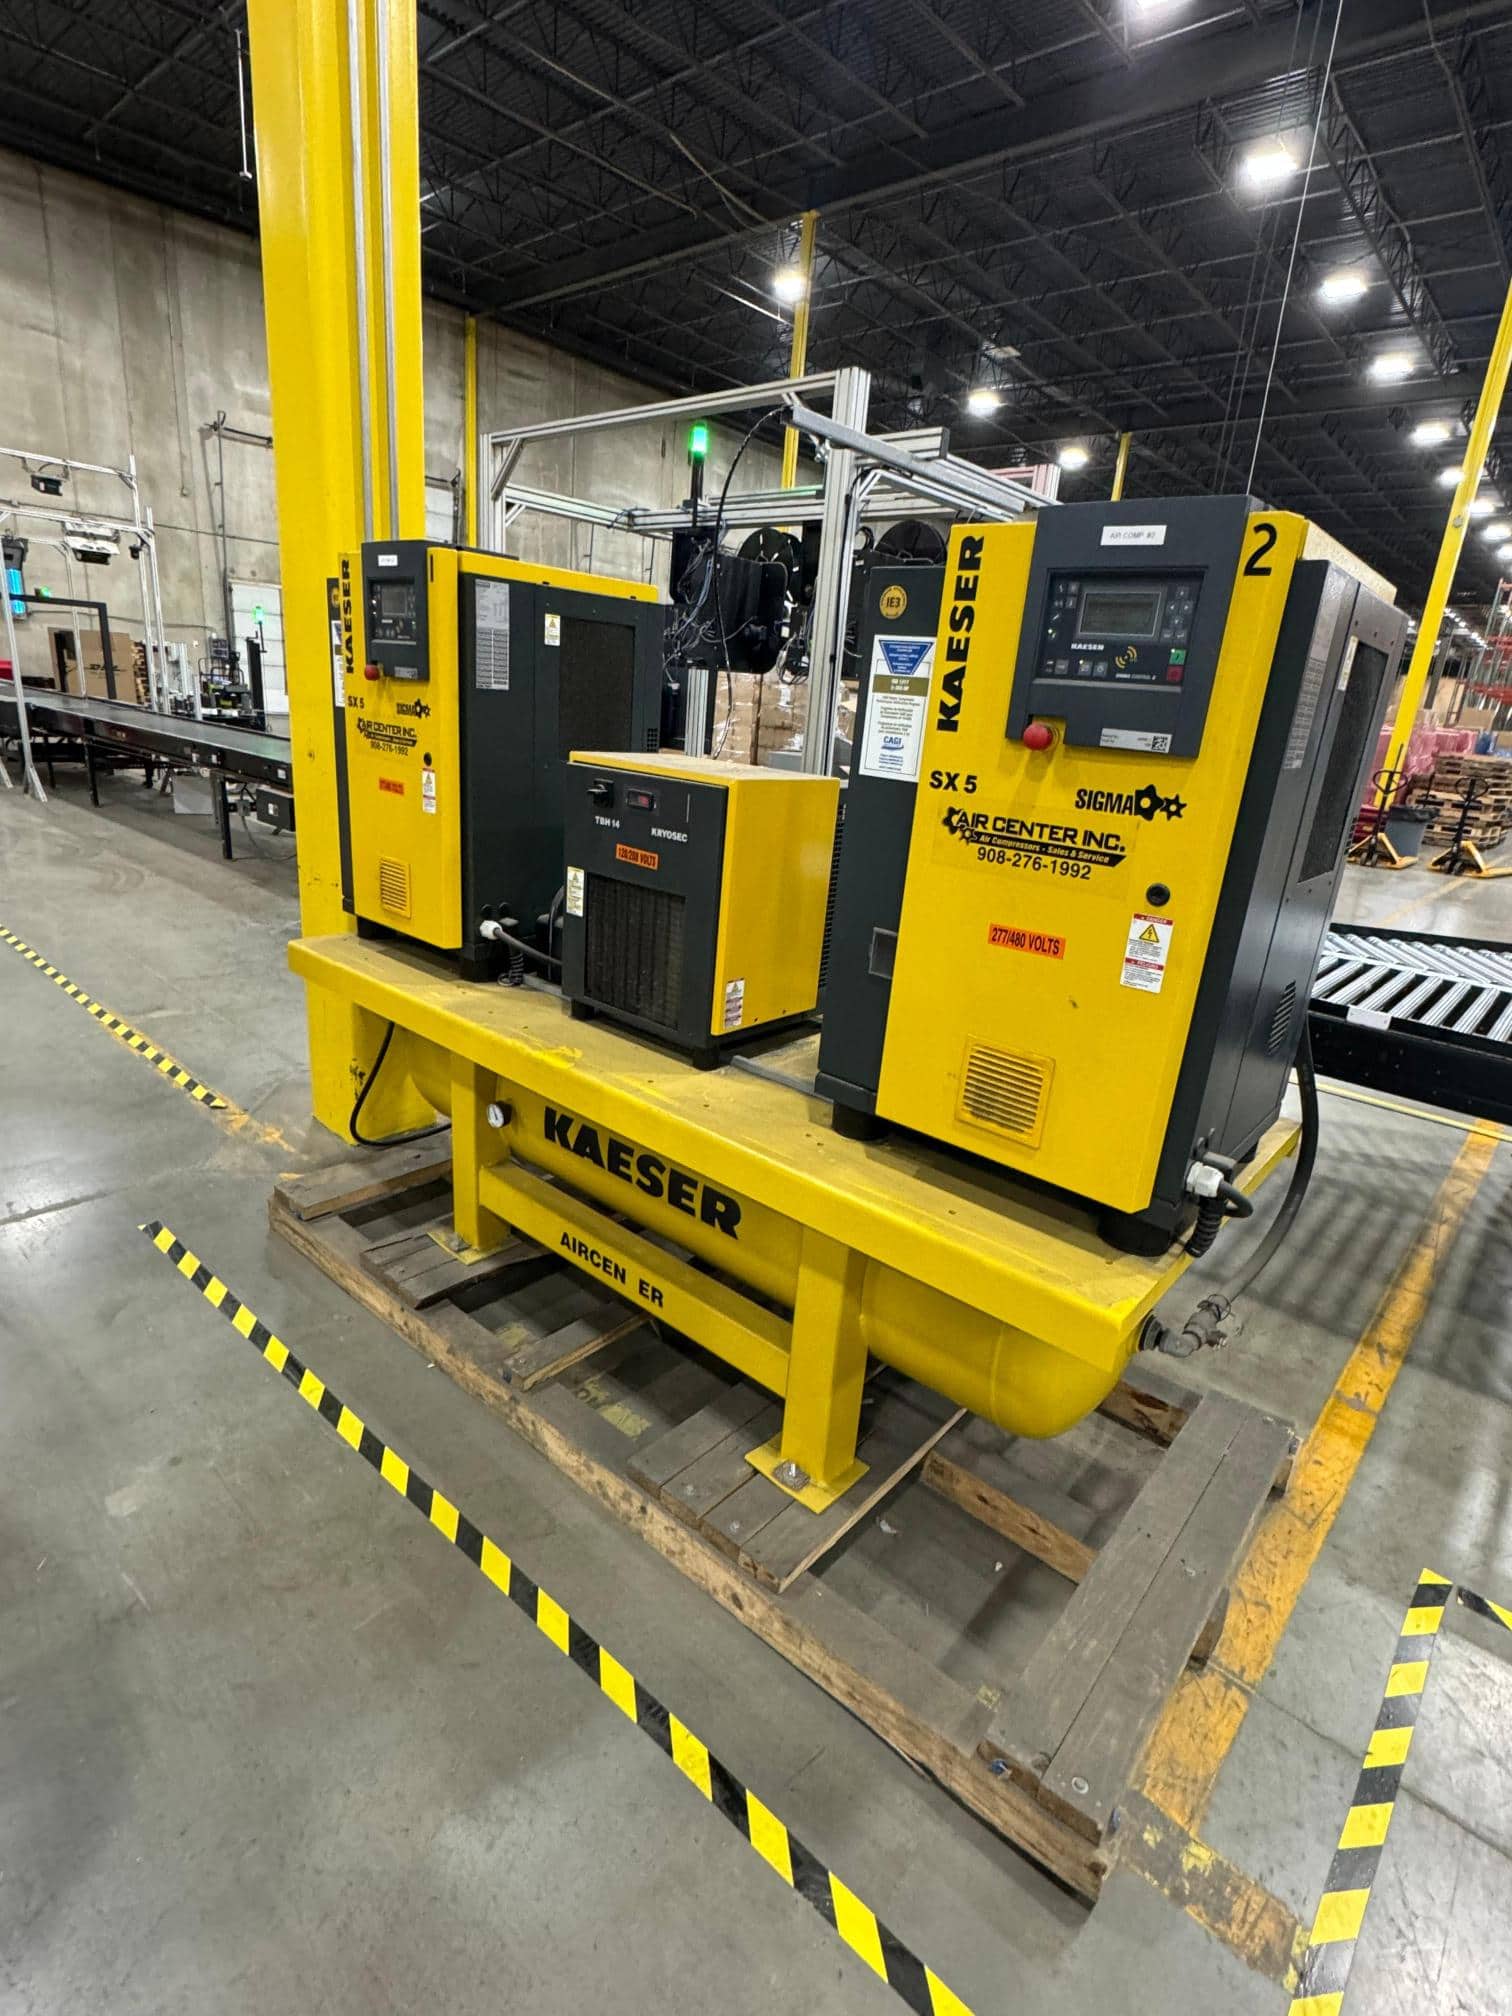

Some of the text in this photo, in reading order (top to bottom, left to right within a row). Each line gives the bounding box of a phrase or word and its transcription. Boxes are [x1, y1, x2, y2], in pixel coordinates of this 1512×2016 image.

[1242, 523, 1277, 577] 2
[341, 559, 354, 674] KAESER
[886, 596, 901, 608] IE3
[937, 535, 985, 731] KAESER
[348, 695, 365, 709] SX 5
[929, 770, 978, 794] SX 5
[1075, 788, 1134, 815] SIGMA
[611, 818, 620, 829] 14
[651, 827, 688, 843] KRYOSEC
[955, 811, 1126, 852] AIR CENTER INC.
[976, 846, 1092, 880] 908-276-1992
[979, 834, 990, 843] Air
[991, 836, 1041, 852] Compressors
[1047, 845, 1069, 857] Sales
[1070, 849, 1077, 858] &
[1077, 850, 1110, 864] Service
[991, 927, 1061, 956] 277/480 VOLTS
[543, 1106, 742, 1240] KAESER
